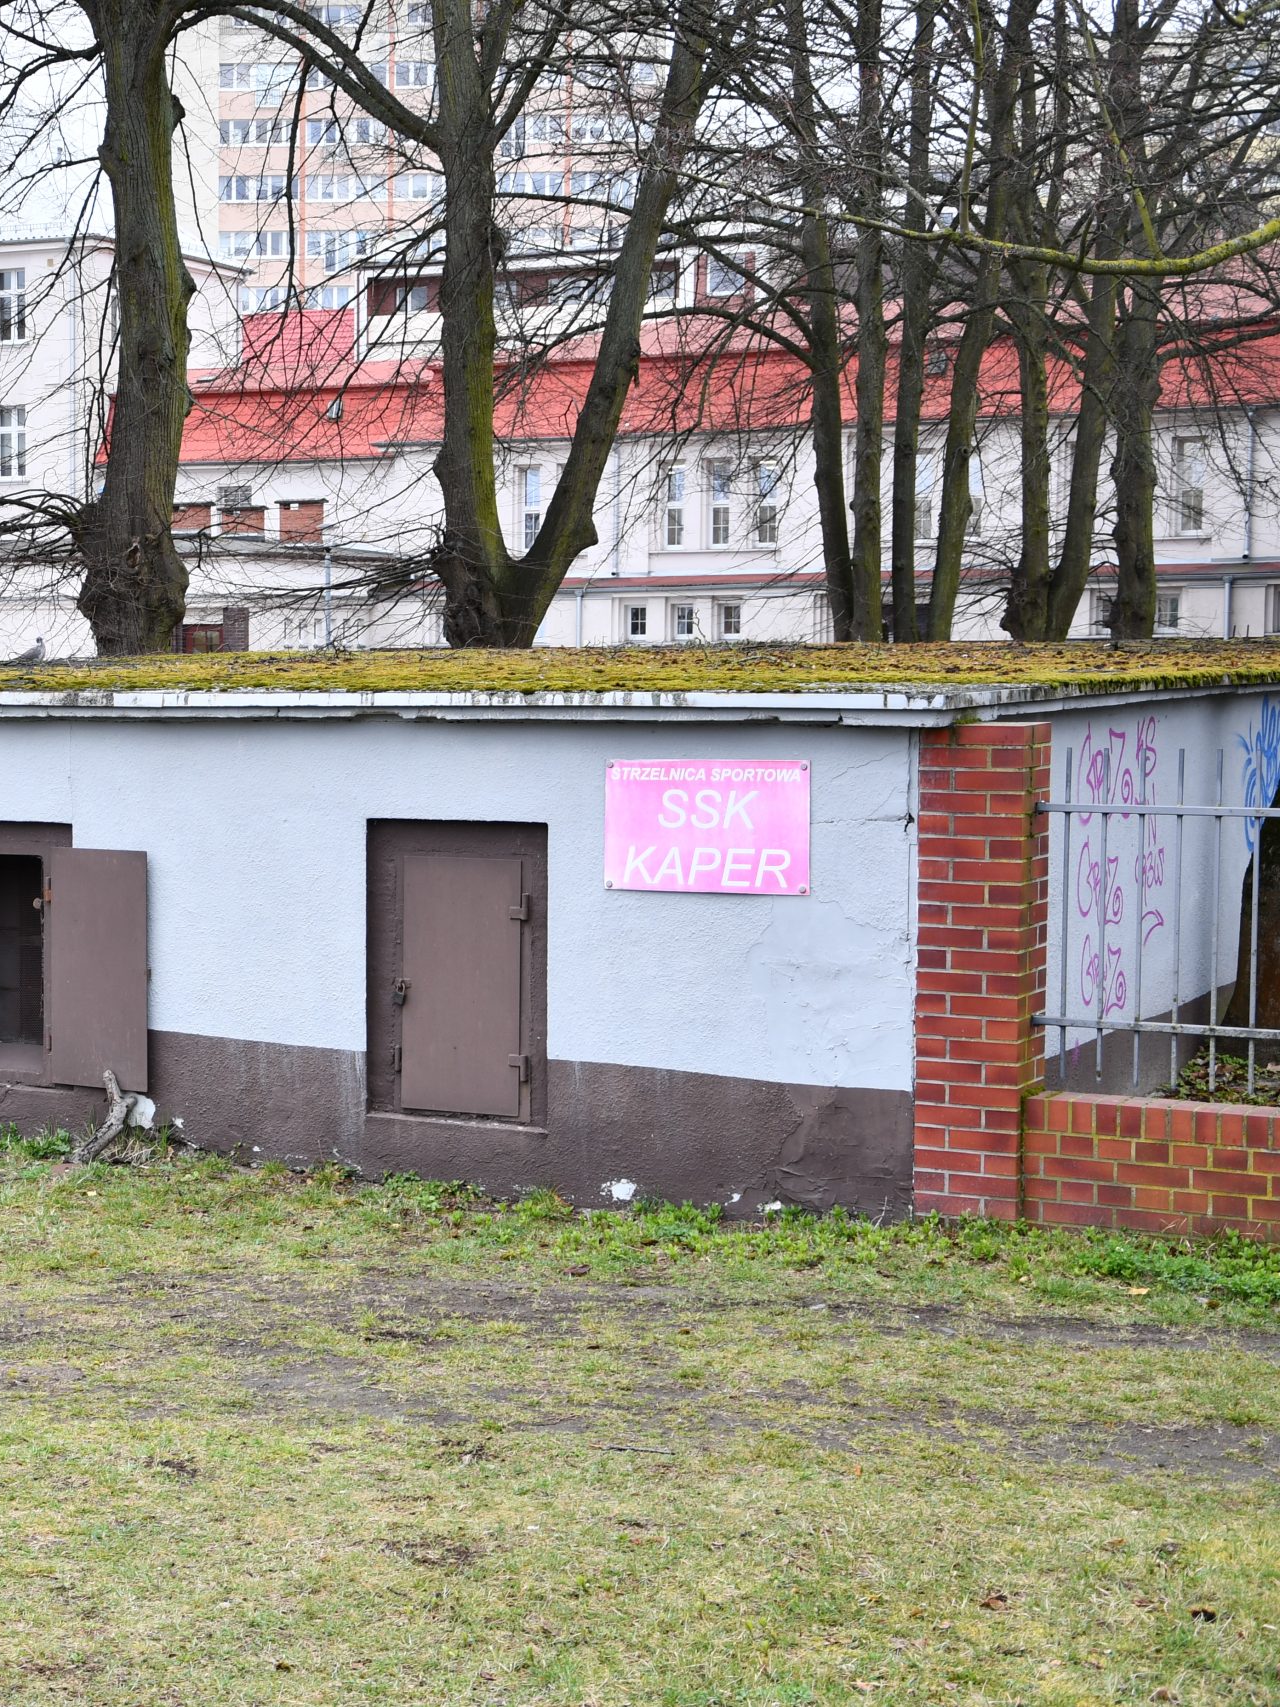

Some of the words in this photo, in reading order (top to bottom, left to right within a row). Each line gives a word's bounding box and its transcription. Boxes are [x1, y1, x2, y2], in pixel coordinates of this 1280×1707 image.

[610, 767, 706, 781] STRZELNICA
[710, 768, 801, 782] SPORTOWA
[657, 788, 760, 830] SSK
[623, 845, 791, 888] KAPER
